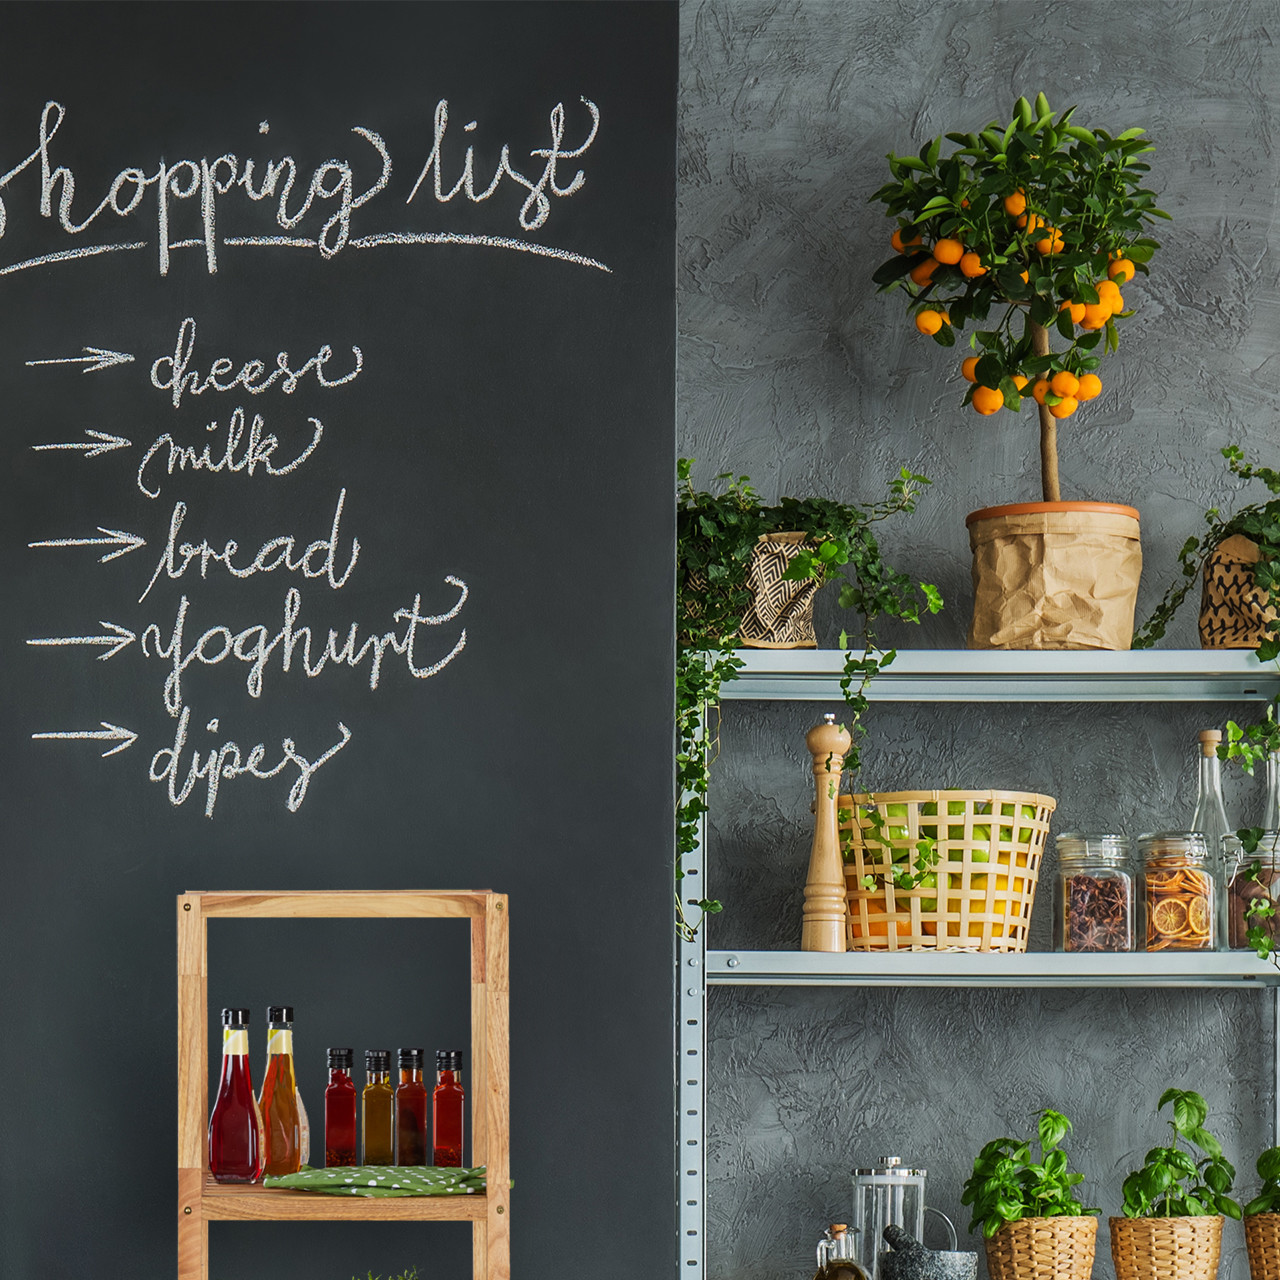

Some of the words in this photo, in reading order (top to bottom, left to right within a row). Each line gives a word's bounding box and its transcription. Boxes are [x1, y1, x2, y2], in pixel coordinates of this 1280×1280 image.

[407, 95, 600, 231] list
[137, 406, 324, 499] milk
[138, 487, 362, 604] bread
